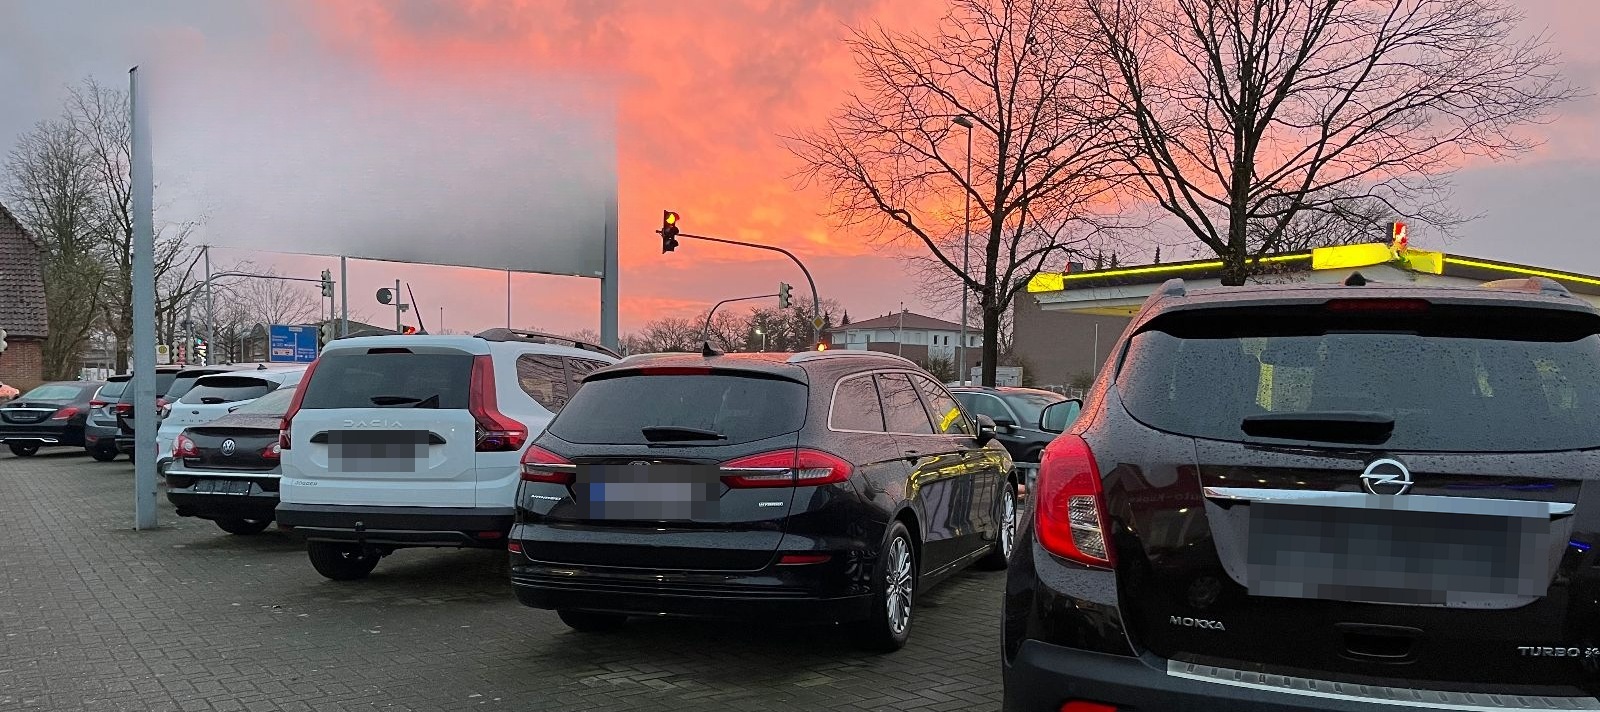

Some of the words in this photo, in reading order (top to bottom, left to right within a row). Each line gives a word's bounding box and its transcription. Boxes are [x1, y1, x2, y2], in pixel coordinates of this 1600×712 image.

[343, 419, 402, 428] DACIA
[1170, 615, 1226, 631] MOKKA
[1517, 646, 1581, 657] TURBO
